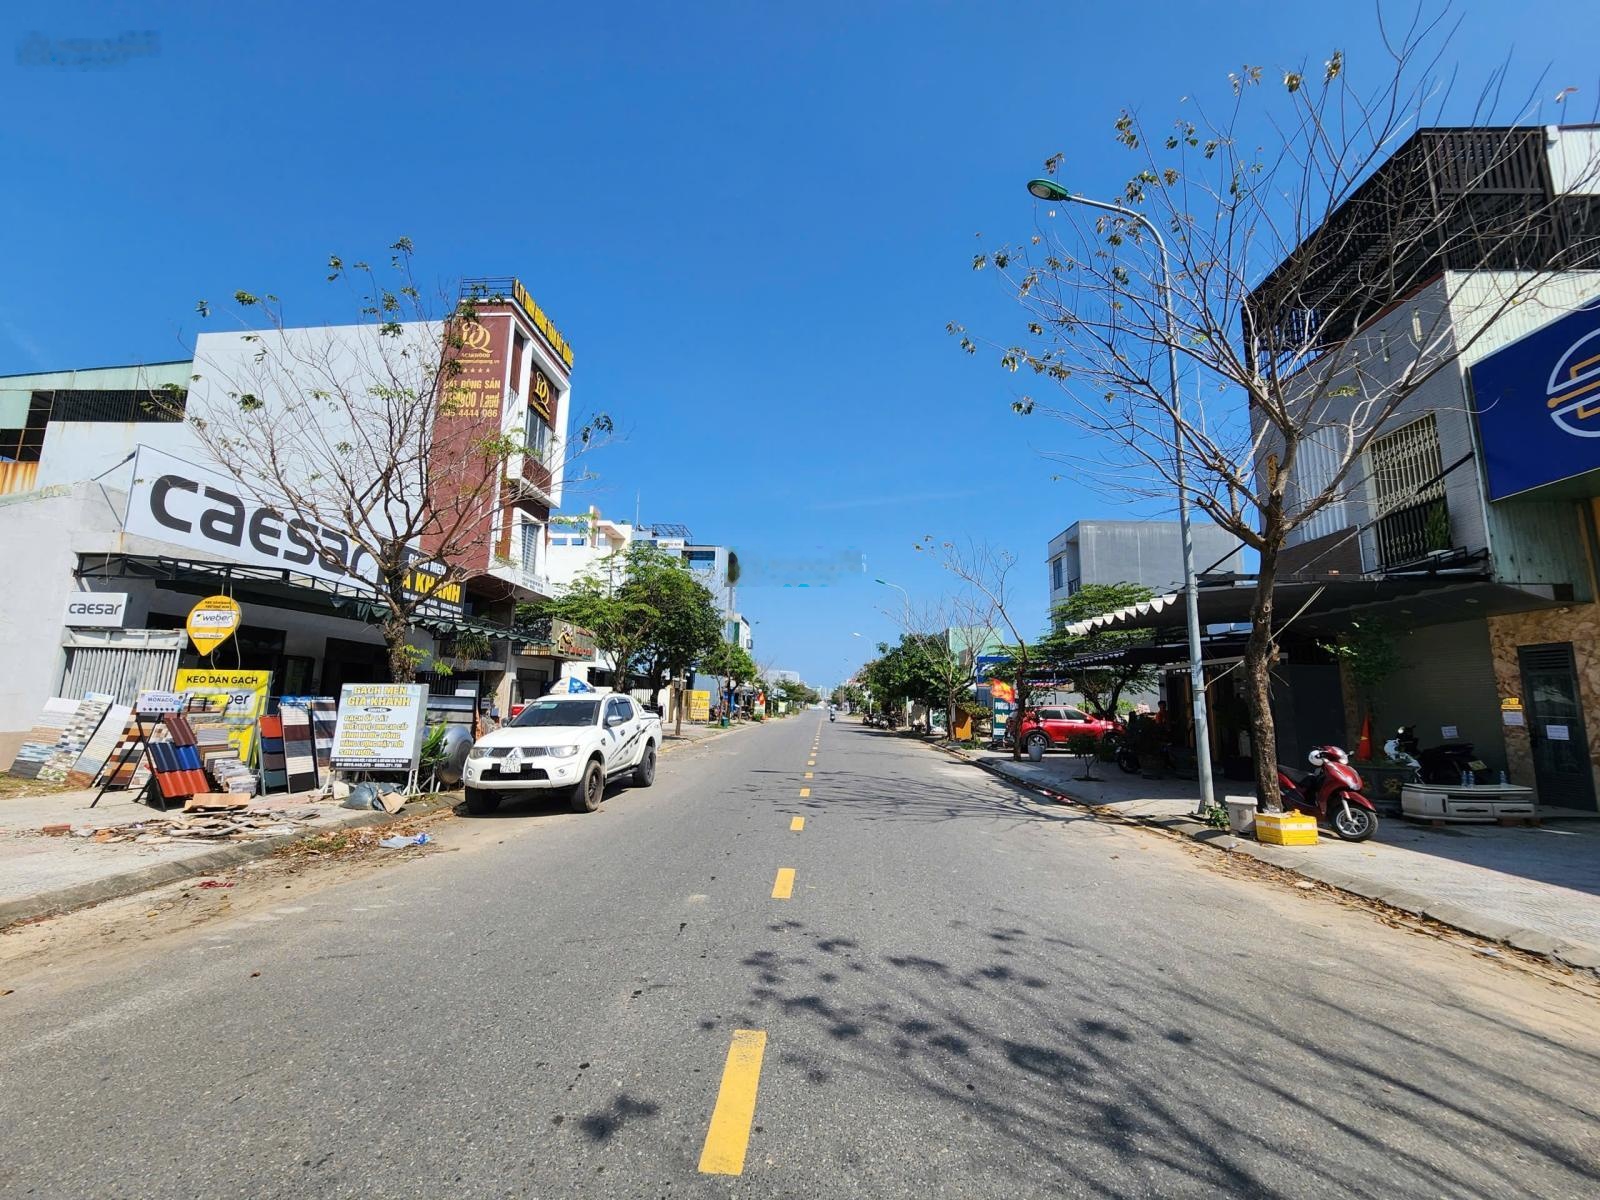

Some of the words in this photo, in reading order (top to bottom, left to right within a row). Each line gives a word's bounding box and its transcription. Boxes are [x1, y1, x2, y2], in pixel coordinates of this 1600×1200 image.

[484, 377, 501, 389] SẢN
[150, 474, 379, 578] caesar
[68, 602, 123, 616] caesar
[202, 612, 232, 622] weber
